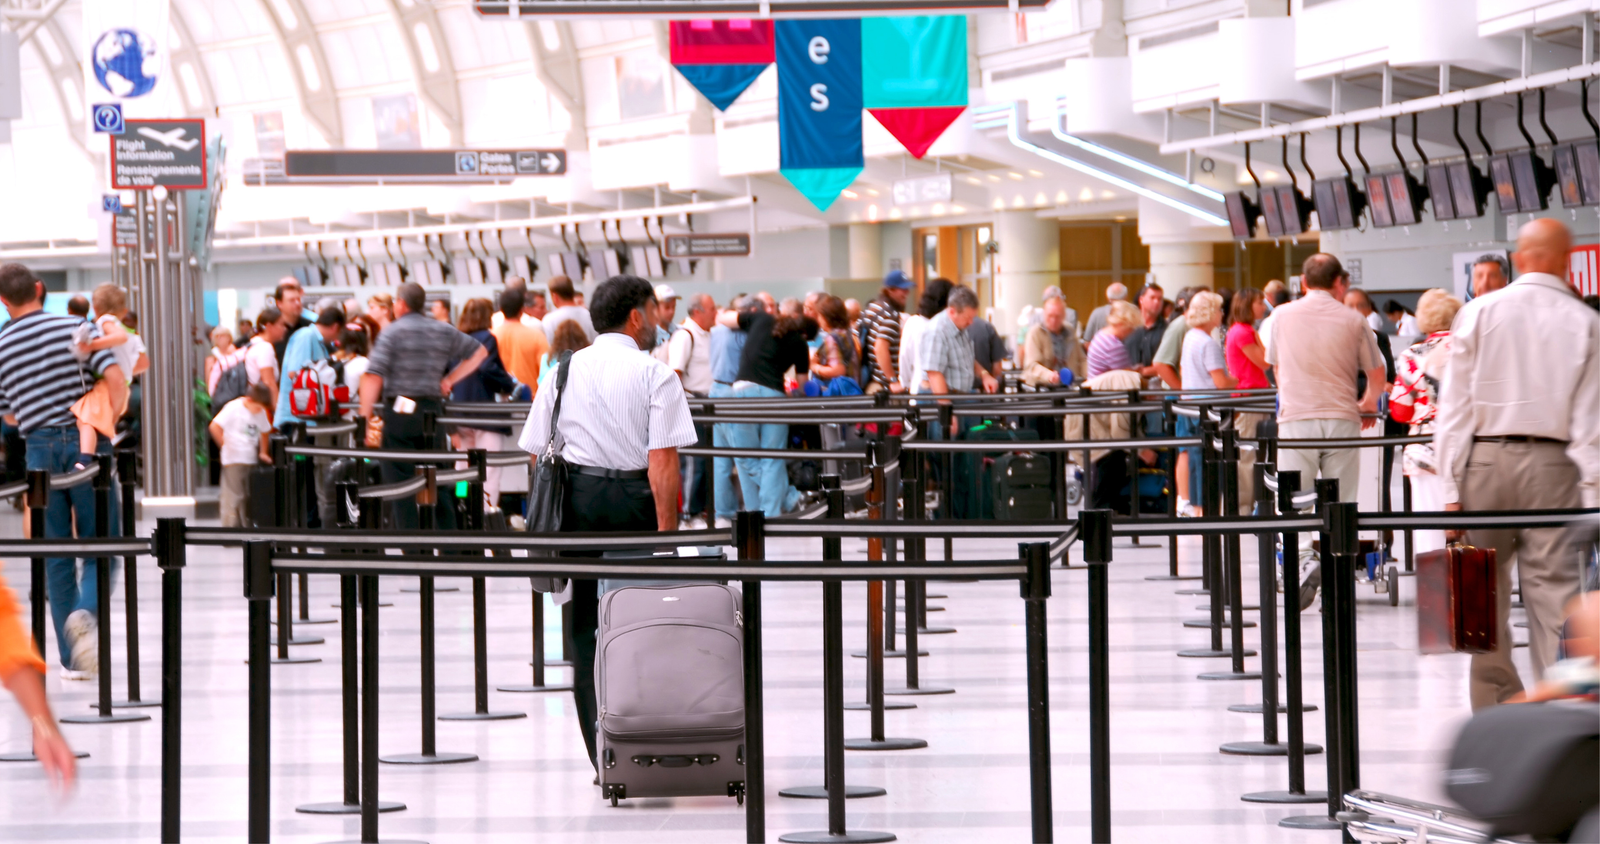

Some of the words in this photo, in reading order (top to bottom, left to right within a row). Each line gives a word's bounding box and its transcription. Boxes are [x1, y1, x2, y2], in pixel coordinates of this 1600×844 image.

[116, 139, 146, 152] Flight
[116, 150, 175, 161] Information
[117, 164, 201, 177] Renseignements
[117, 175, 131, 185] de
